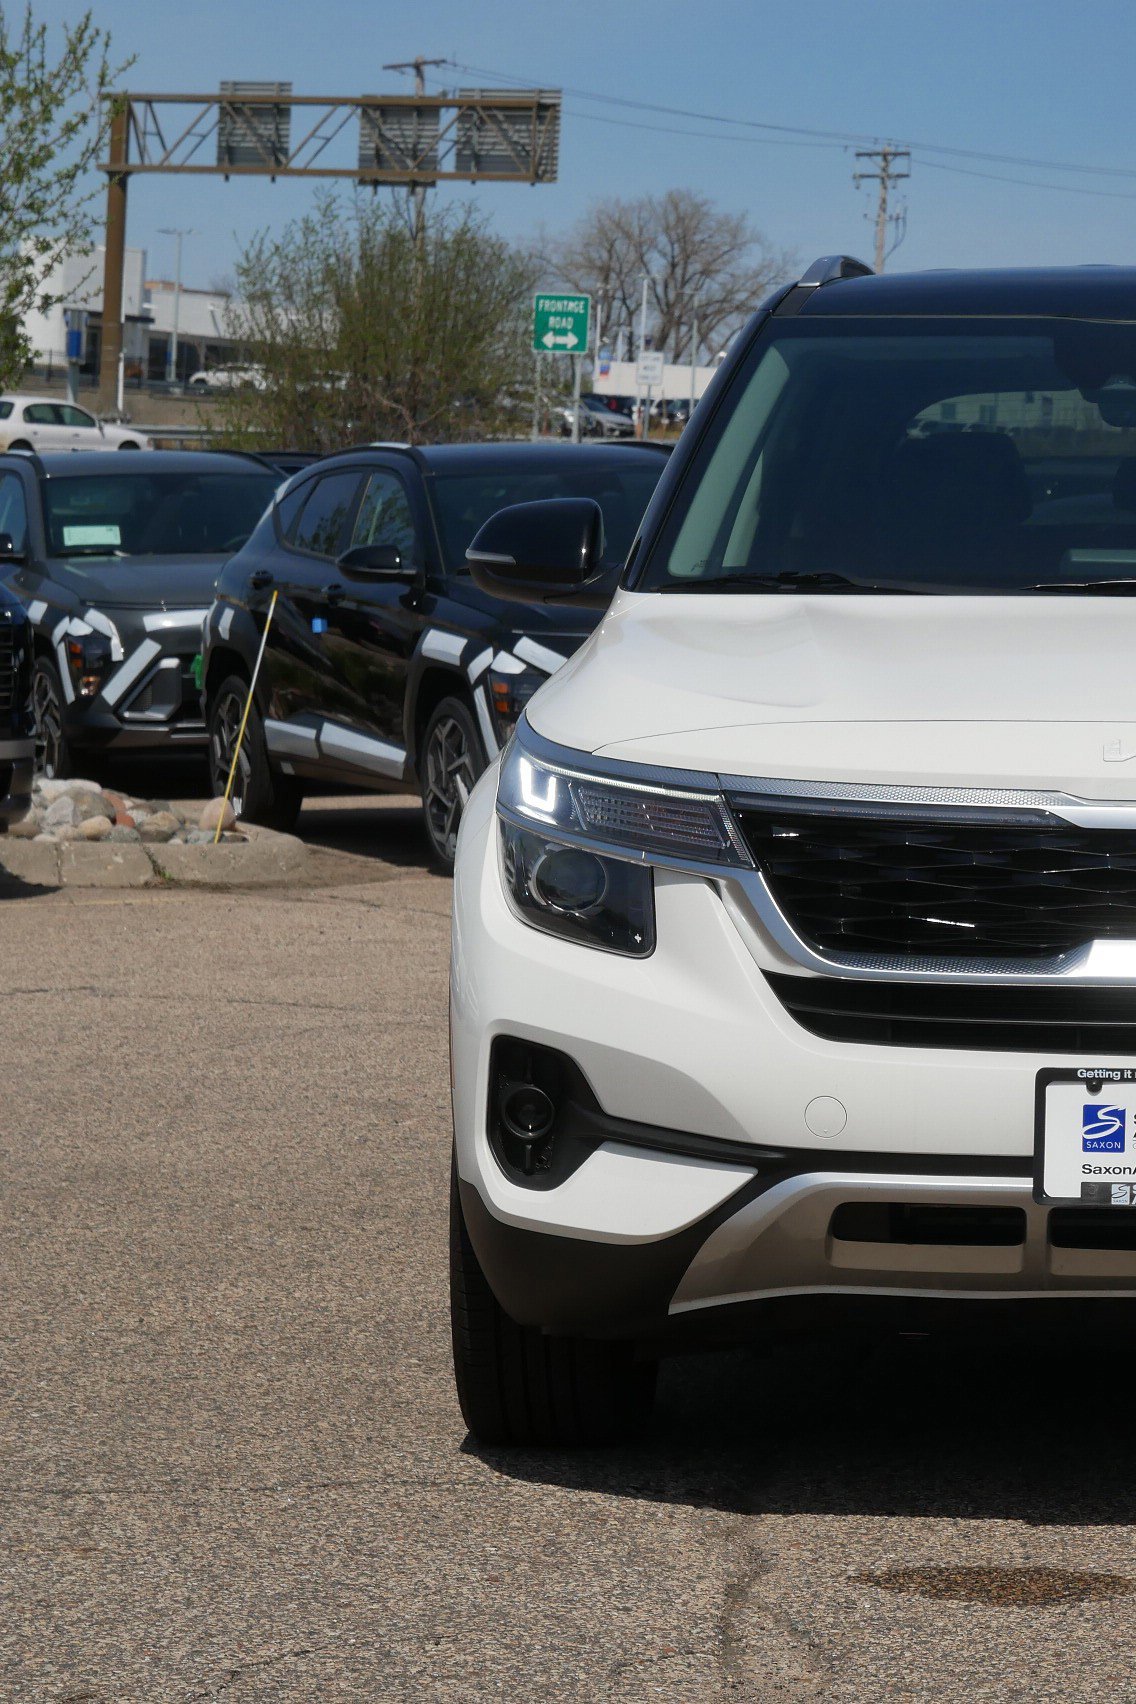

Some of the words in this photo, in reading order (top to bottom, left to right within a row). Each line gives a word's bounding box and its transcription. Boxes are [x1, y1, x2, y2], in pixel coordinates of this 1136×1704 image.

[538, 299, 585, 313] FRONTAGE
[548, 316, 573, 329] ROAD
[1077, 1069, 1120, 1080] Getting
[1123, 1070, 1132, 1079] it
[1086, 1141, 1121, 1149] SAXON
